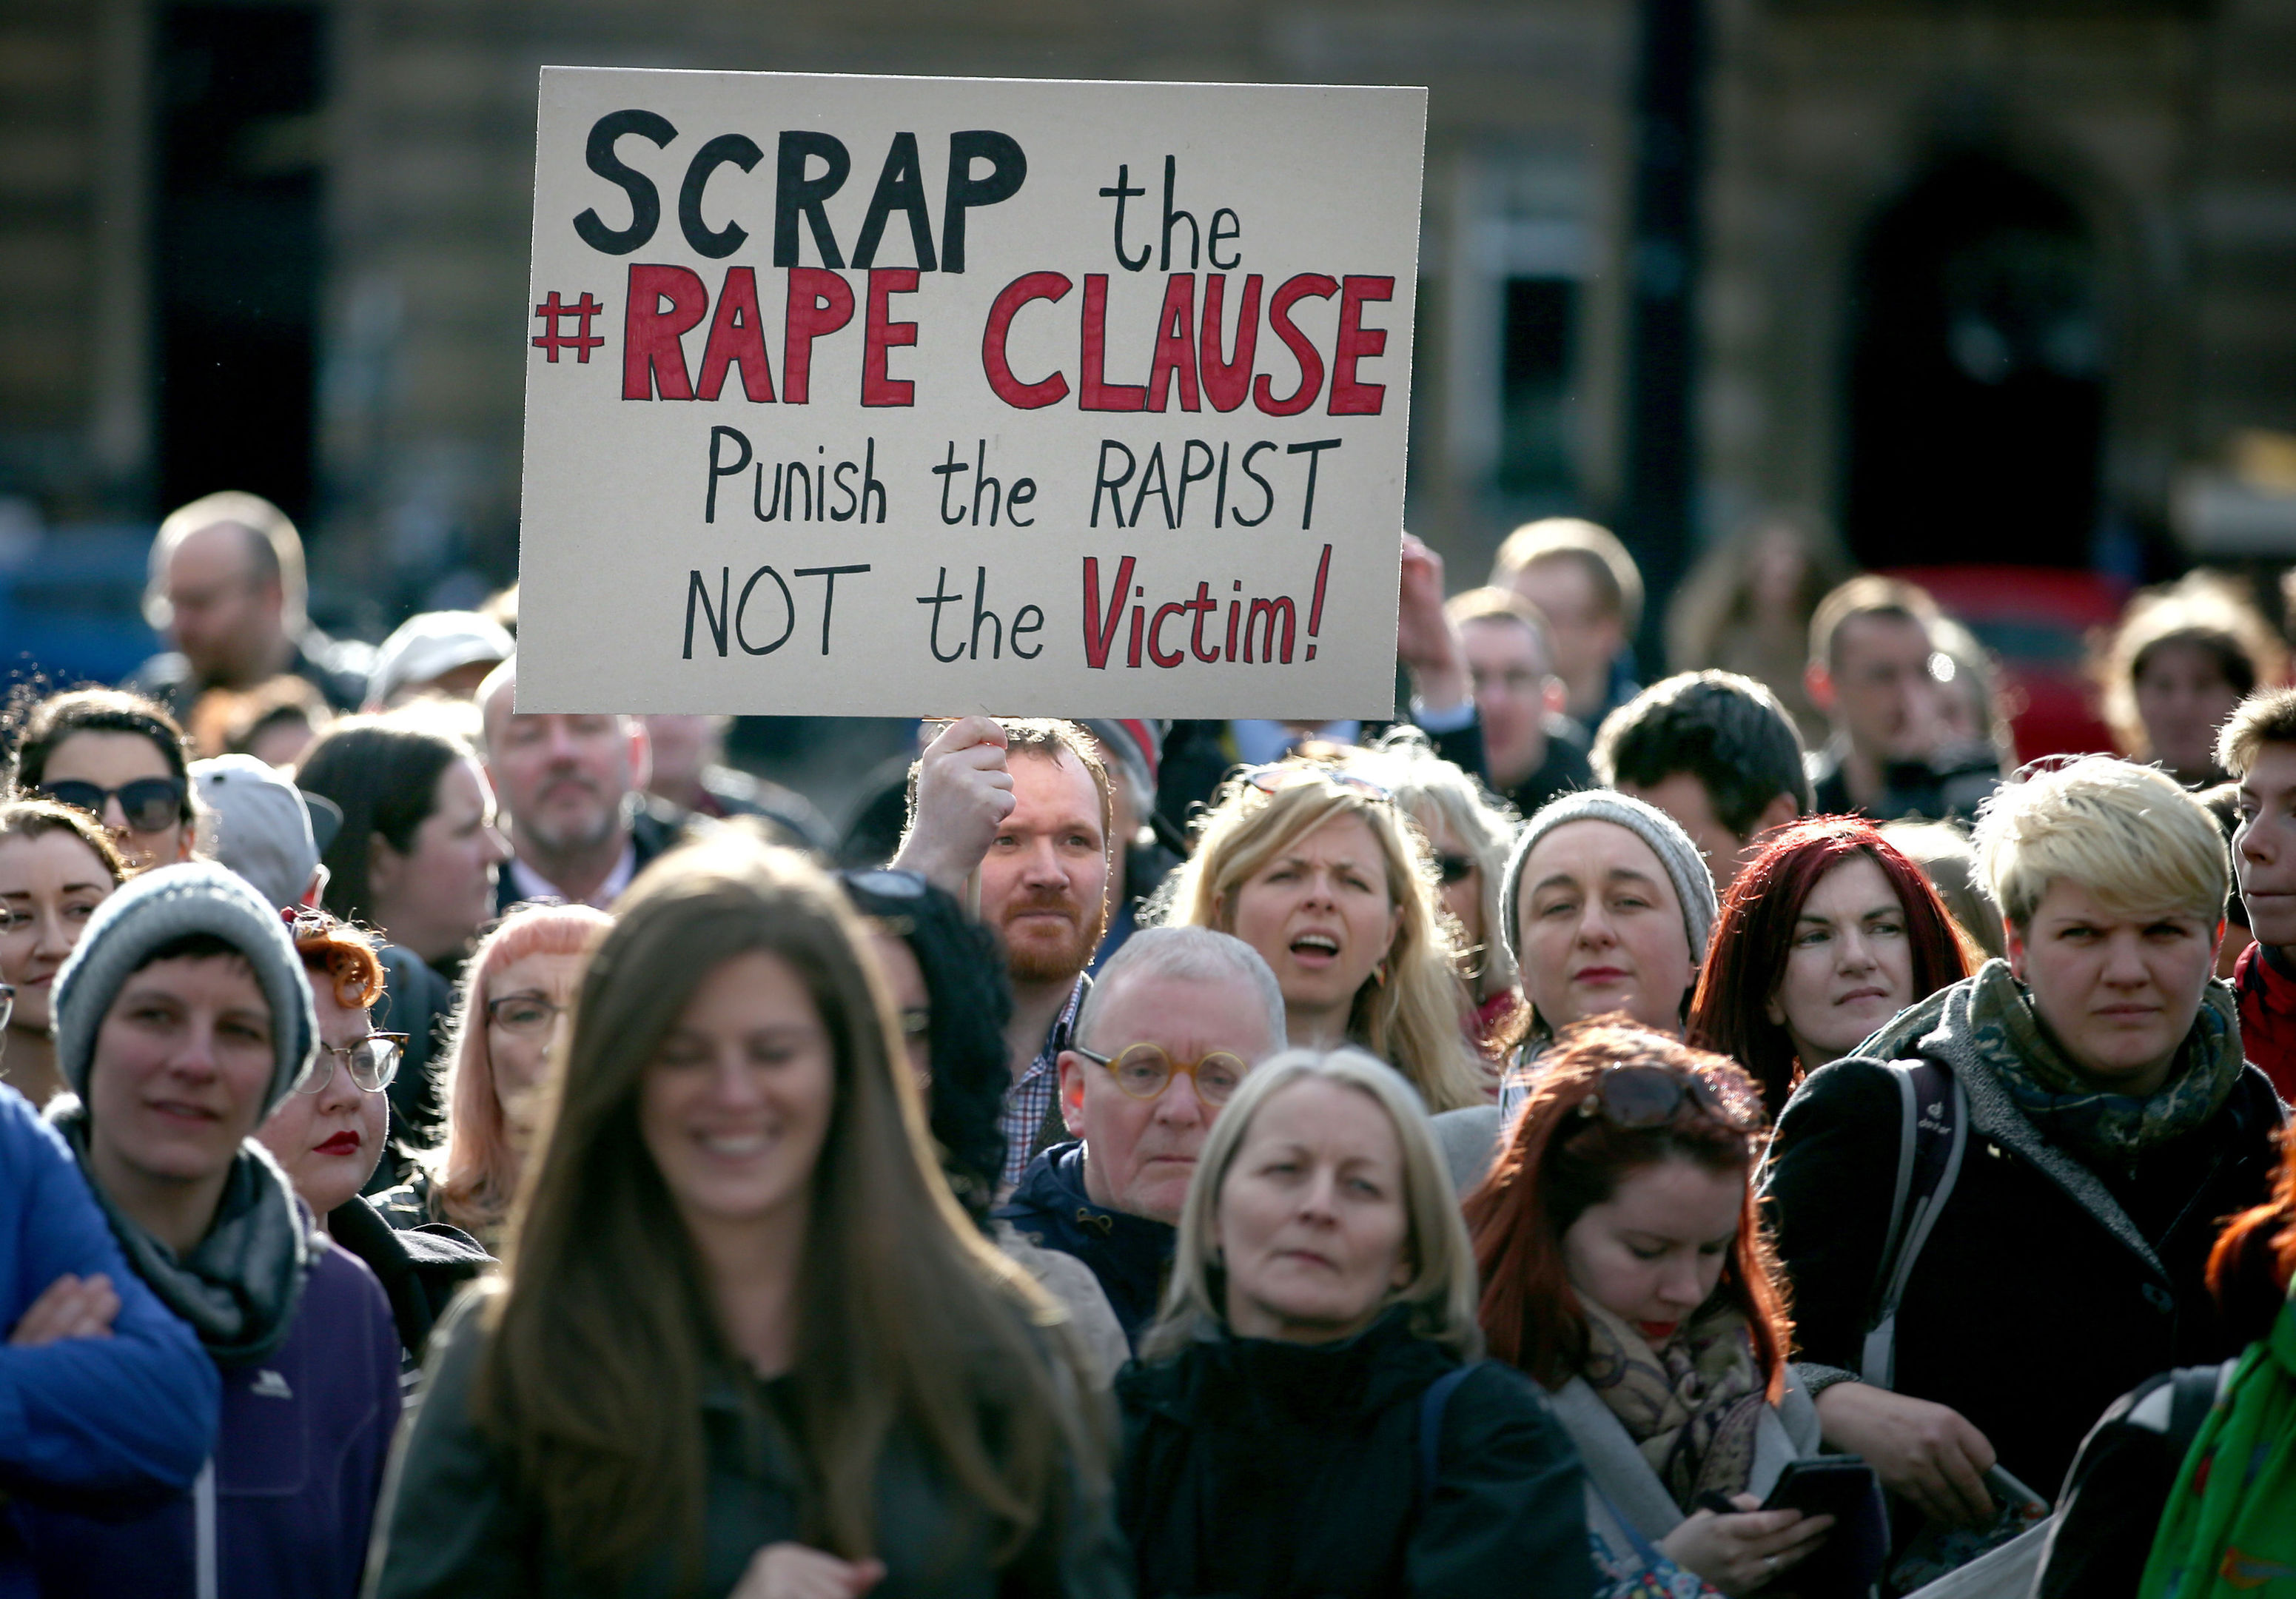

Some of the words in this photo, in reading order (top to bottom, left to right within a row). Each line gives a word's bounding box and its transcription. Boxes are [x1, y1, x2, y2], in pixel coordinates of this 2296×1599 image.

[573, 108, 1028, 274] SCRAP
[1099, 153, 1242, 273] the
[531, 263, 922, 409] #RAPE
[981, 271, 1396, 418] CLAUSE
[705, 425, 887, 524] Punish
[931, 439, 1037, 528] the
[1090, 437, 1342, 531] RAPIST
[682, 563, 871, 661] NOT
[916, 566, 1044, 663] the
[1081, 543, 1332, 670] Victim!
